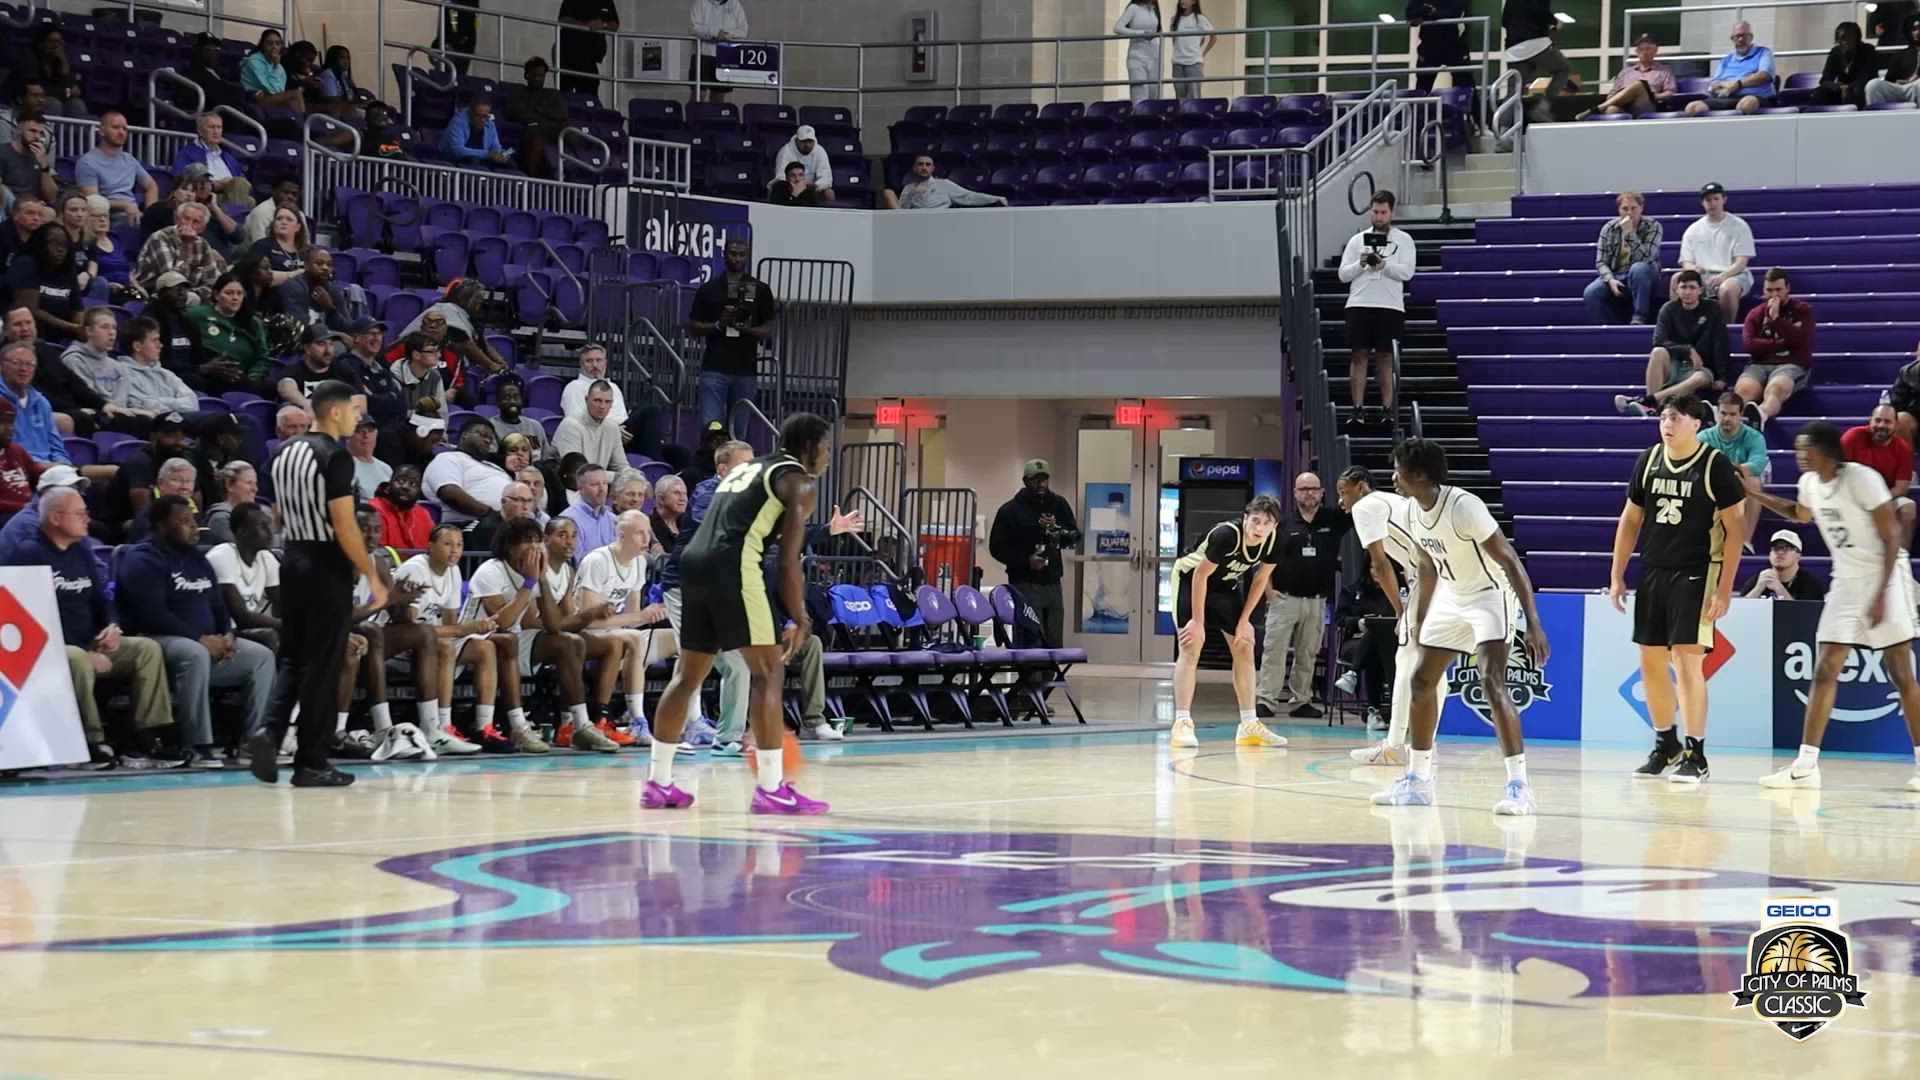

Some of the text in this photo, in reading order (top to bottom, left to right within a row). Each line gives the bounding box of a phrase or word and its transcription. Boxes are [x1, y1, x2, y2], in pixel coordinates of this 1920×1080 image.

[739, 49, 767, 66] 120
[879, 406, 901, 425] EXIT
[1120, 406, 1141, 425] EXIT
[715, 462, 763, 493] 23
[1206, 464, 1241, 477] pepsi
[1651, 477, 1693, 498] PAUL VI
[1655, 497, 1684, 525] 25
[1783, 641, 1918, 683] aex
[1507, 668, 1539, 686] PALMS
[1470, 686, 1523, 704] CLIC
